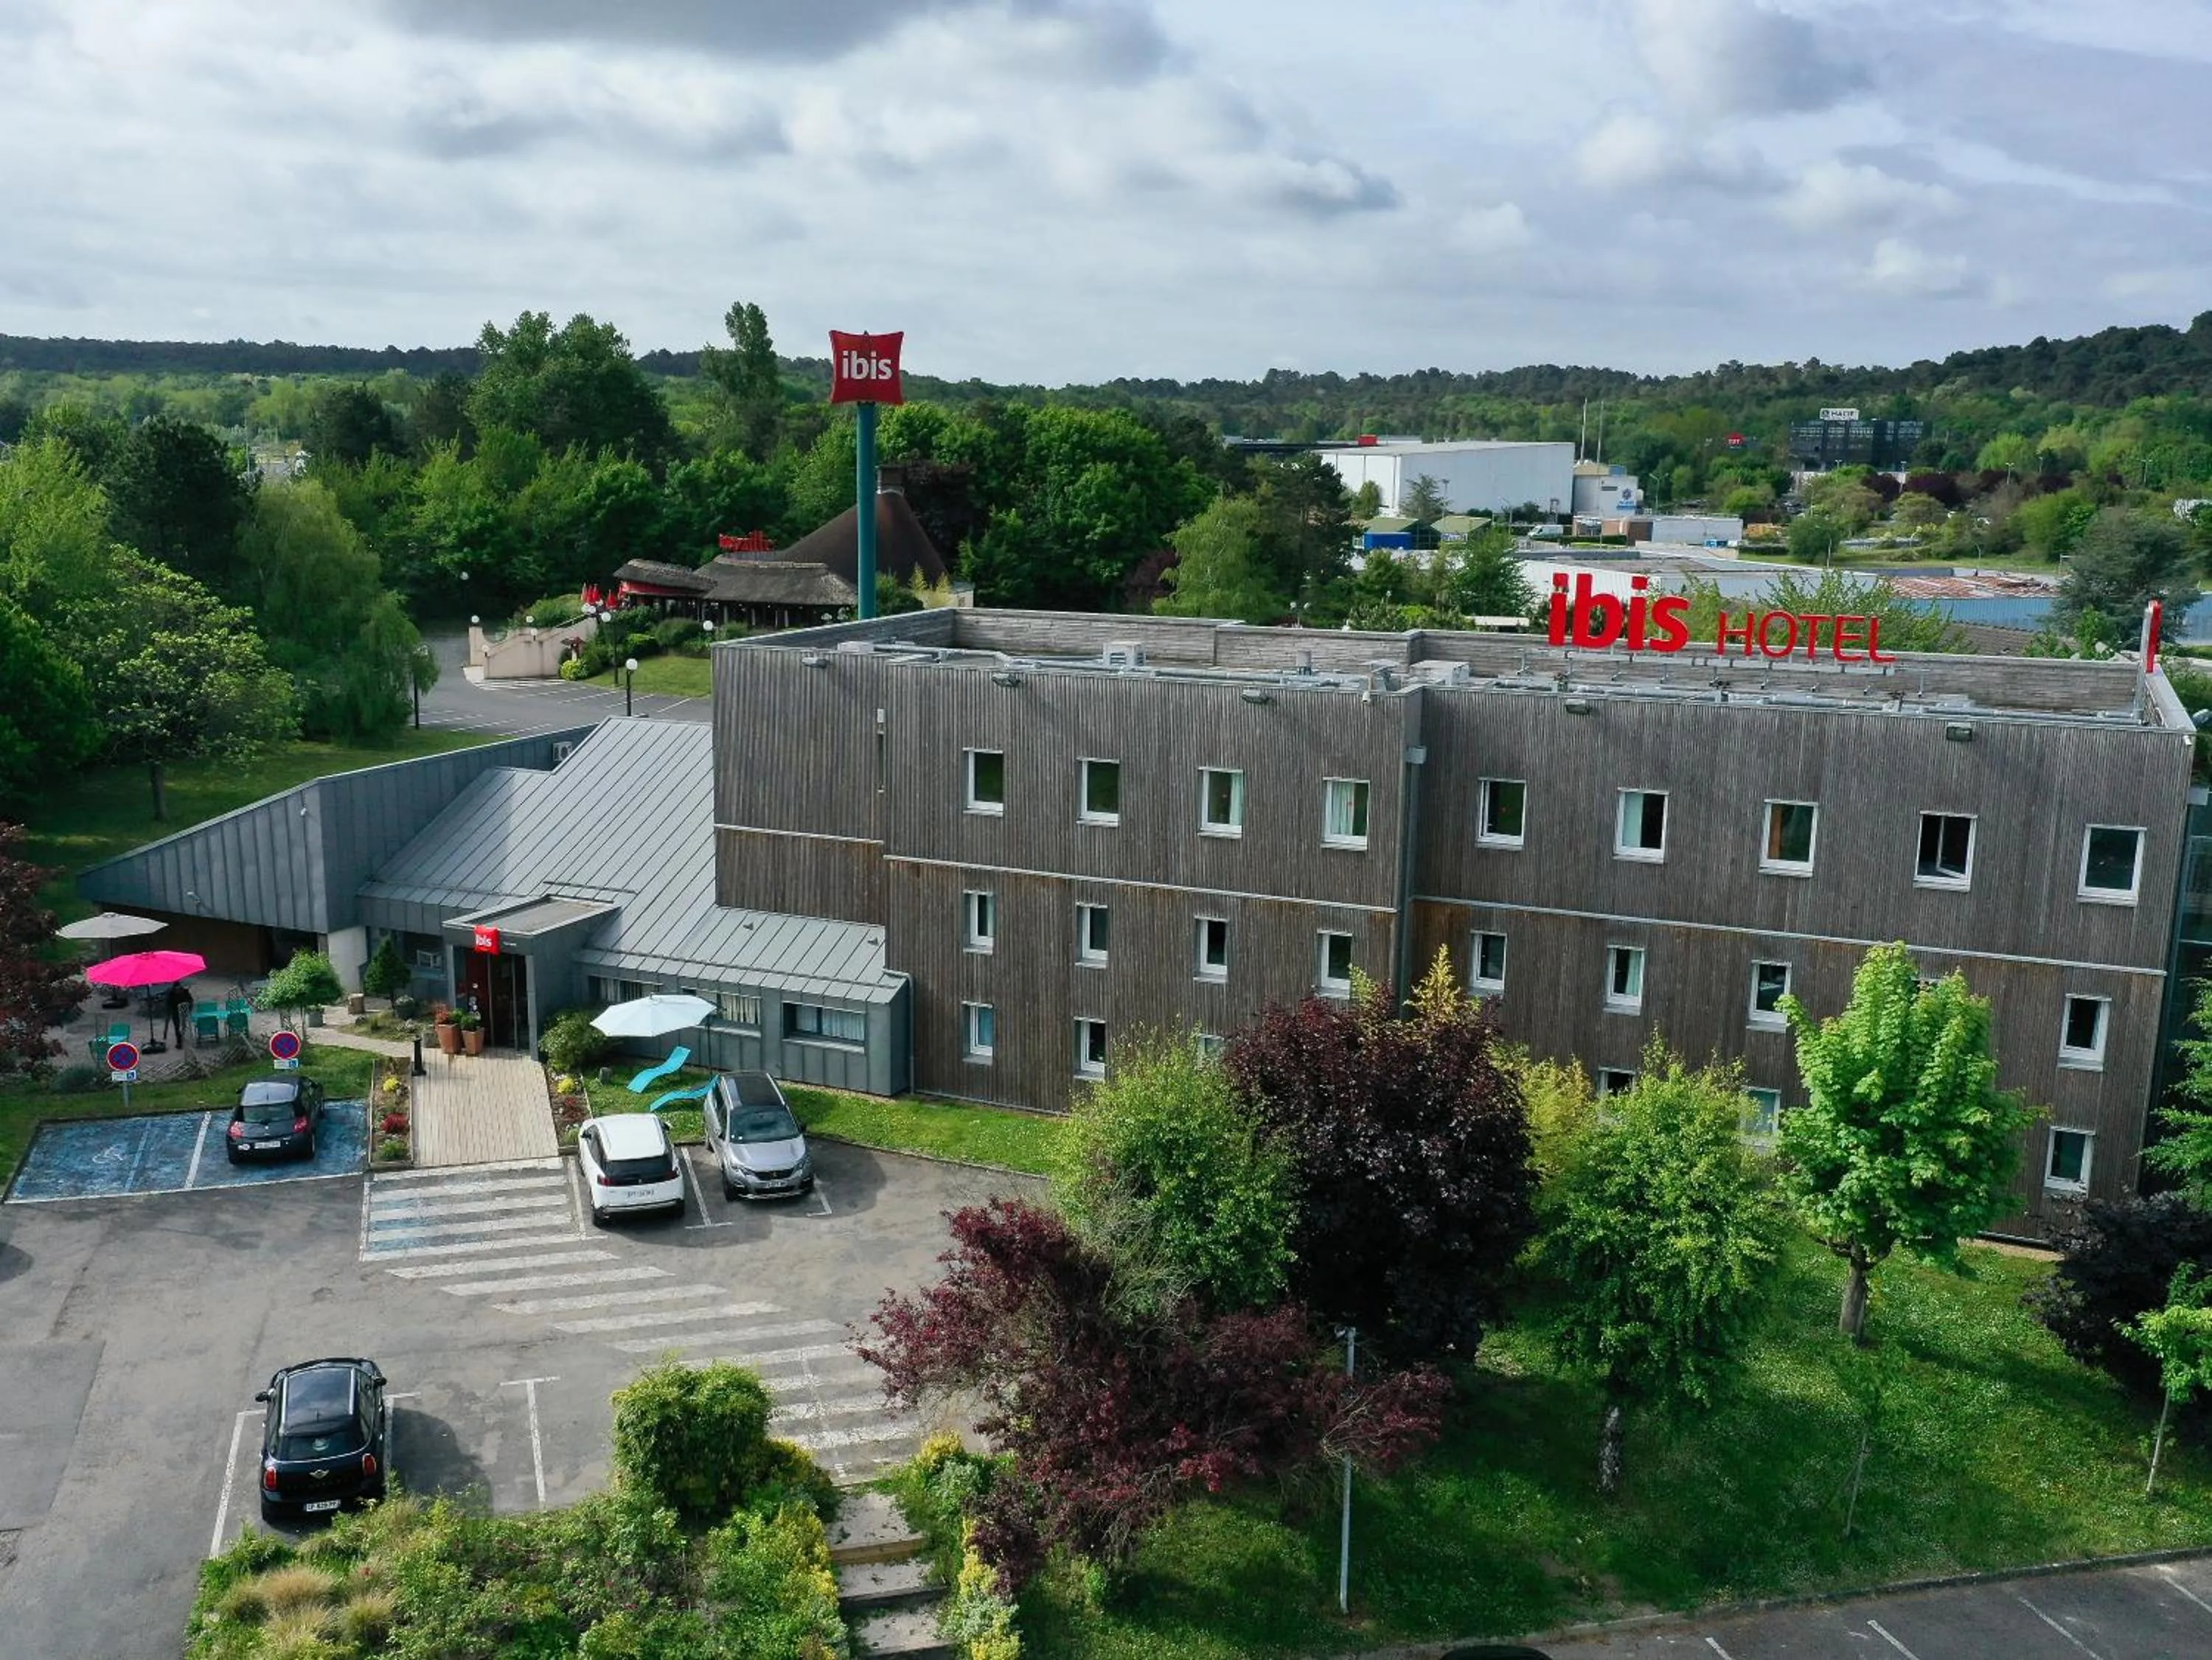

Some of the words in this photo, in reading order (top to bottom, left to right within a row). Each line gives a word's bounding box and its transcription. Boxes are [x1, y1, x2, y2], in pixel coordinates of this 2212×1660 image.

[842, 349, 893, 380] ibis
[1548, 572, 1691, 652] ibis
[1716, 610, 1899, 663] HOTEL
[476, 933, 493, 947] ibis
